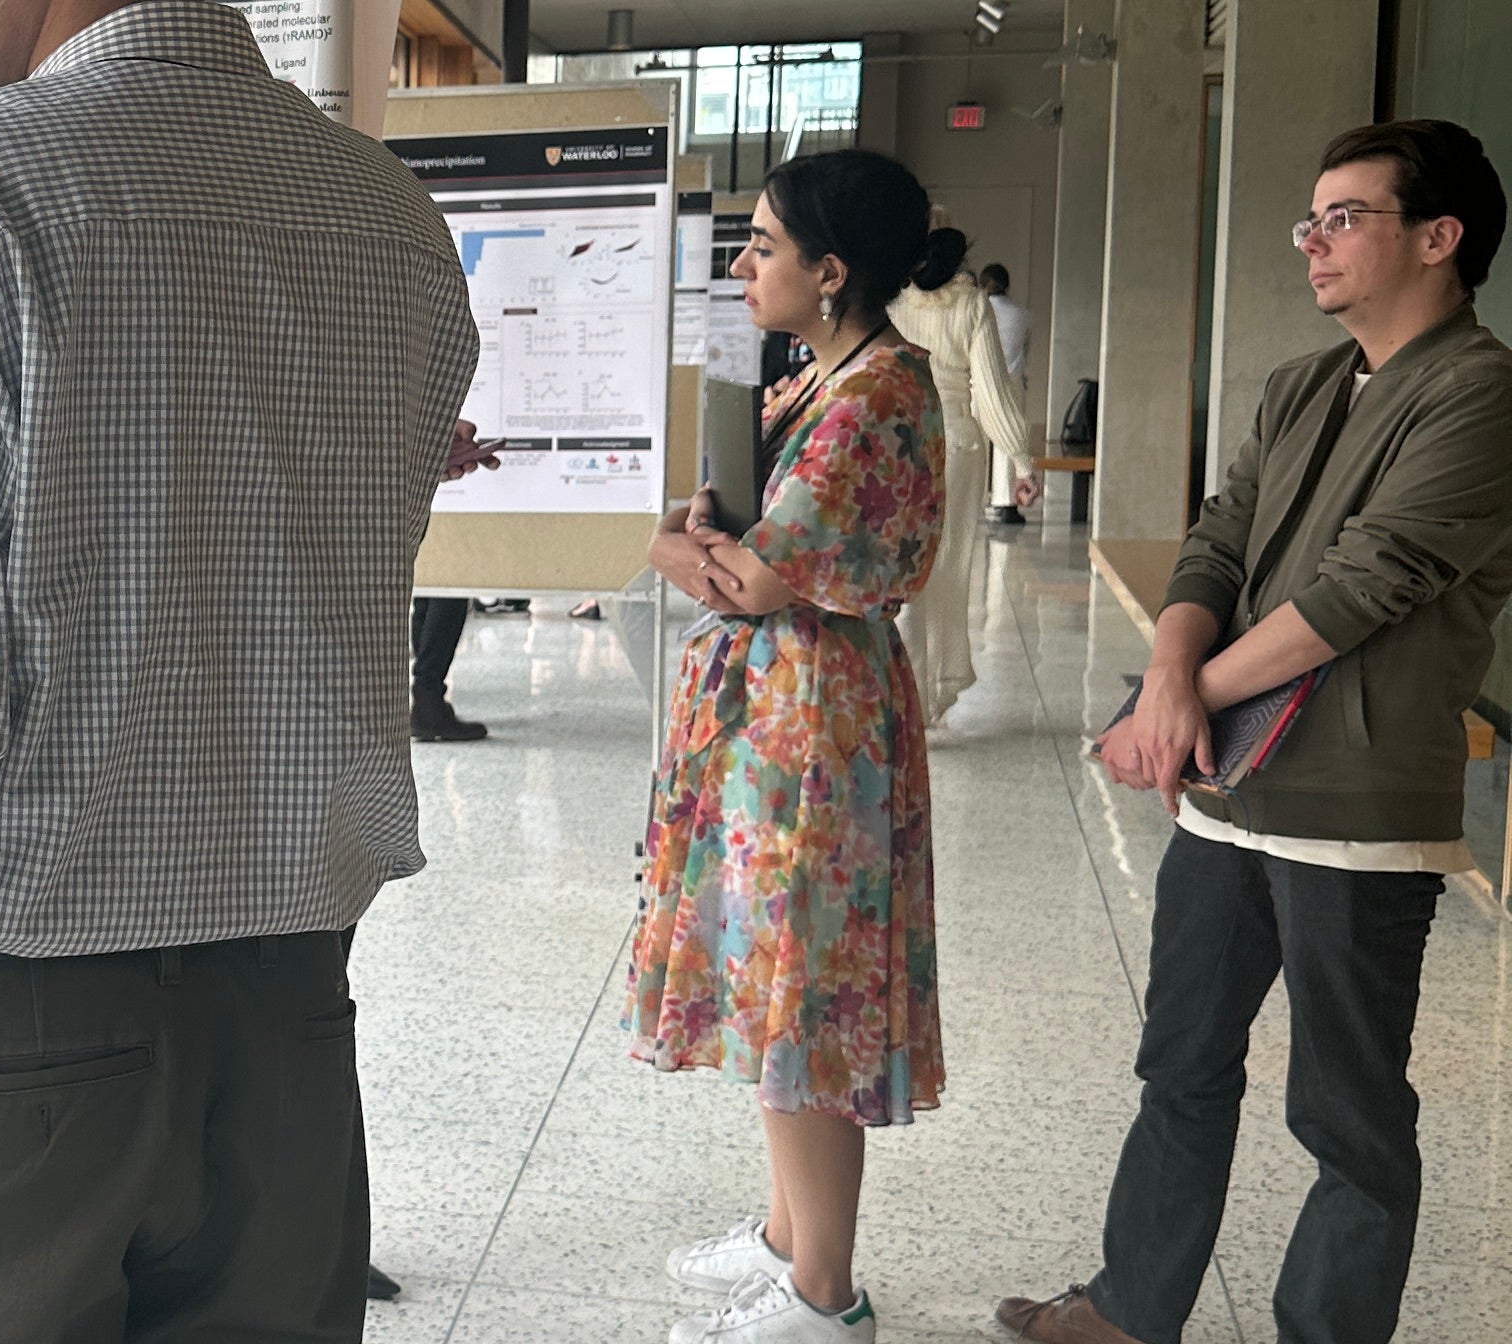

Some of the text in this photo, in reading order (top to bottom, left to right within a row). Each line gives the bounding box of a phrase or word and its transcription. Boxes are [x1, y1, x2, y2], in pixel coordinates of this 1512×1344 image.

[282, 15, 331, 26] molecular
[275, 57, 306, 70] Ligand
[562, 149, 618, 161] WATERLOO
